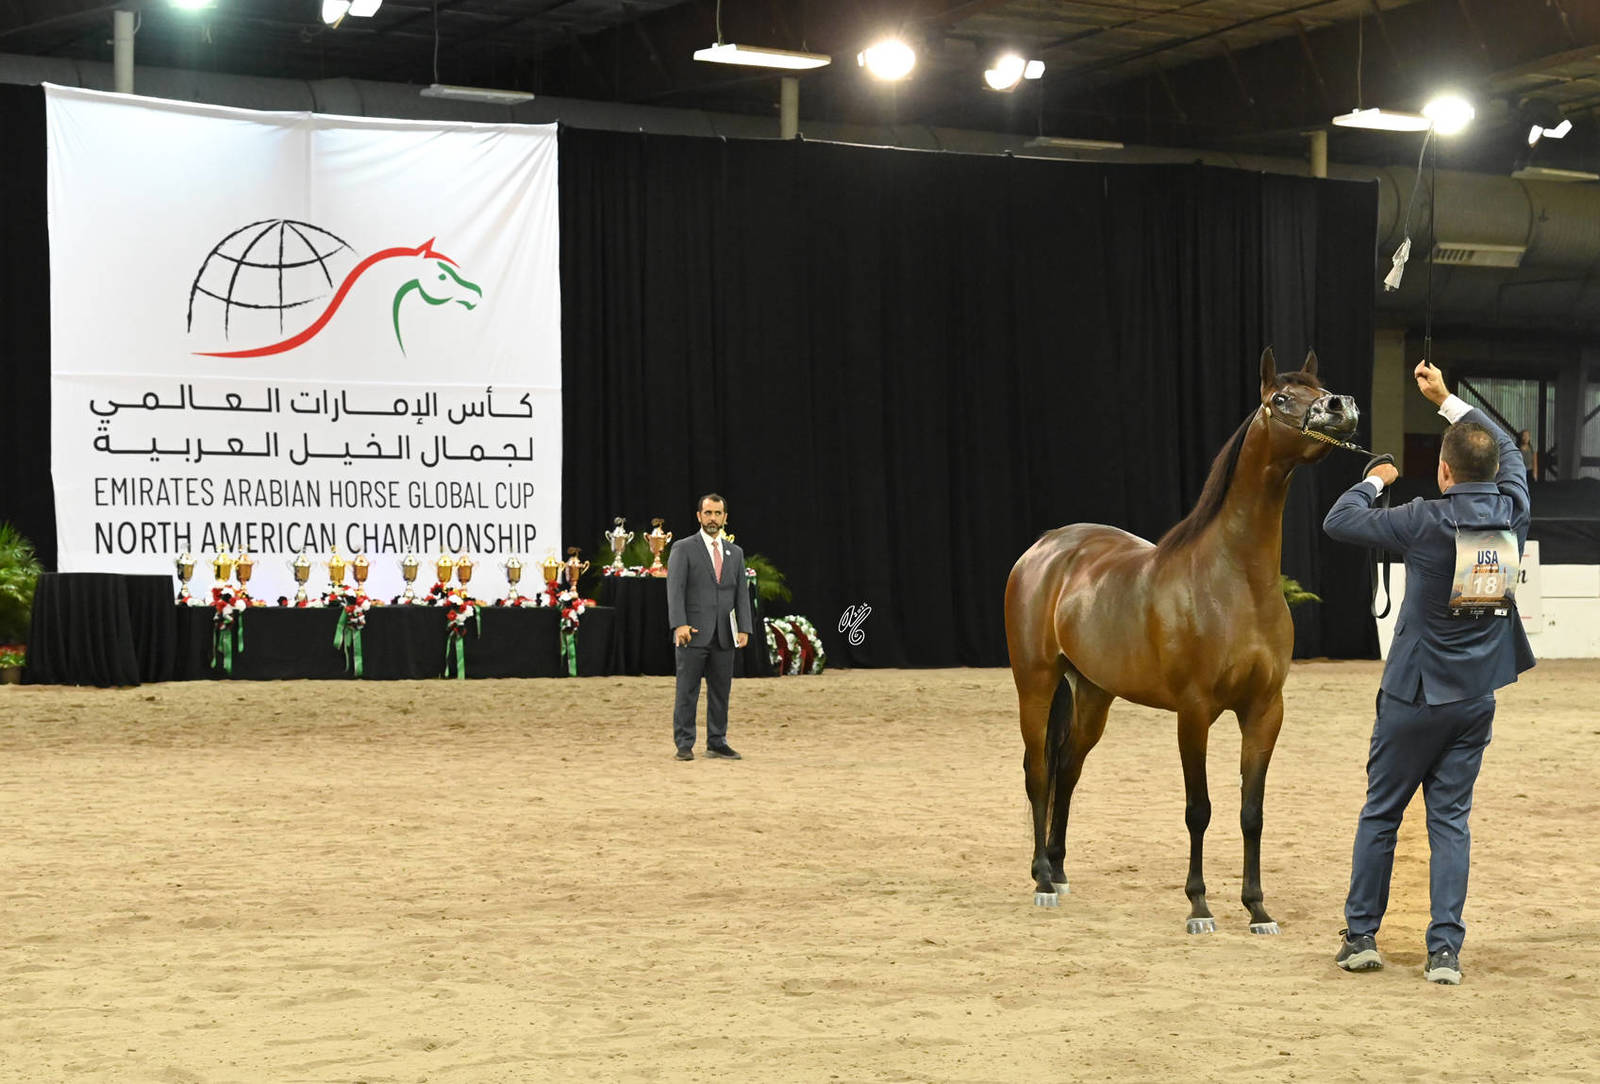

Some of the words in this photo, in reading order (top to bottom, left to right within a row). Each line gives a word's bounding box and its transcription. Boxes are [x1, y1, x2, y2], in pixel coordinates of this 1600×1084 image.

[89, 383, 281, 425] العالمي
[290, 389, 438, 425] الإمارات
[447, 385, 533, 425] كأس
[93, 426, 279, 464] العربية
[289, 432, 411, 466] الخيل
[420, 435, 534, 468] لجمال
[95, 477, 214, 507] EMIRATES
[223, 478, 321, 508] ARABIAN
[329, 480, 401, 509] HORSE
[408, 481, 489, 509] GLOBAL
[495, 481, 534, 509] CUP
[95, 521, 192, 555] NORTH
[200, 521, 336, 555] AMERICAN
[345, 522, 537, 555] CHAMPIONSHIP
[1477, 550, 1498, 564] USA
[1474, 577, 1497, 594] 18
